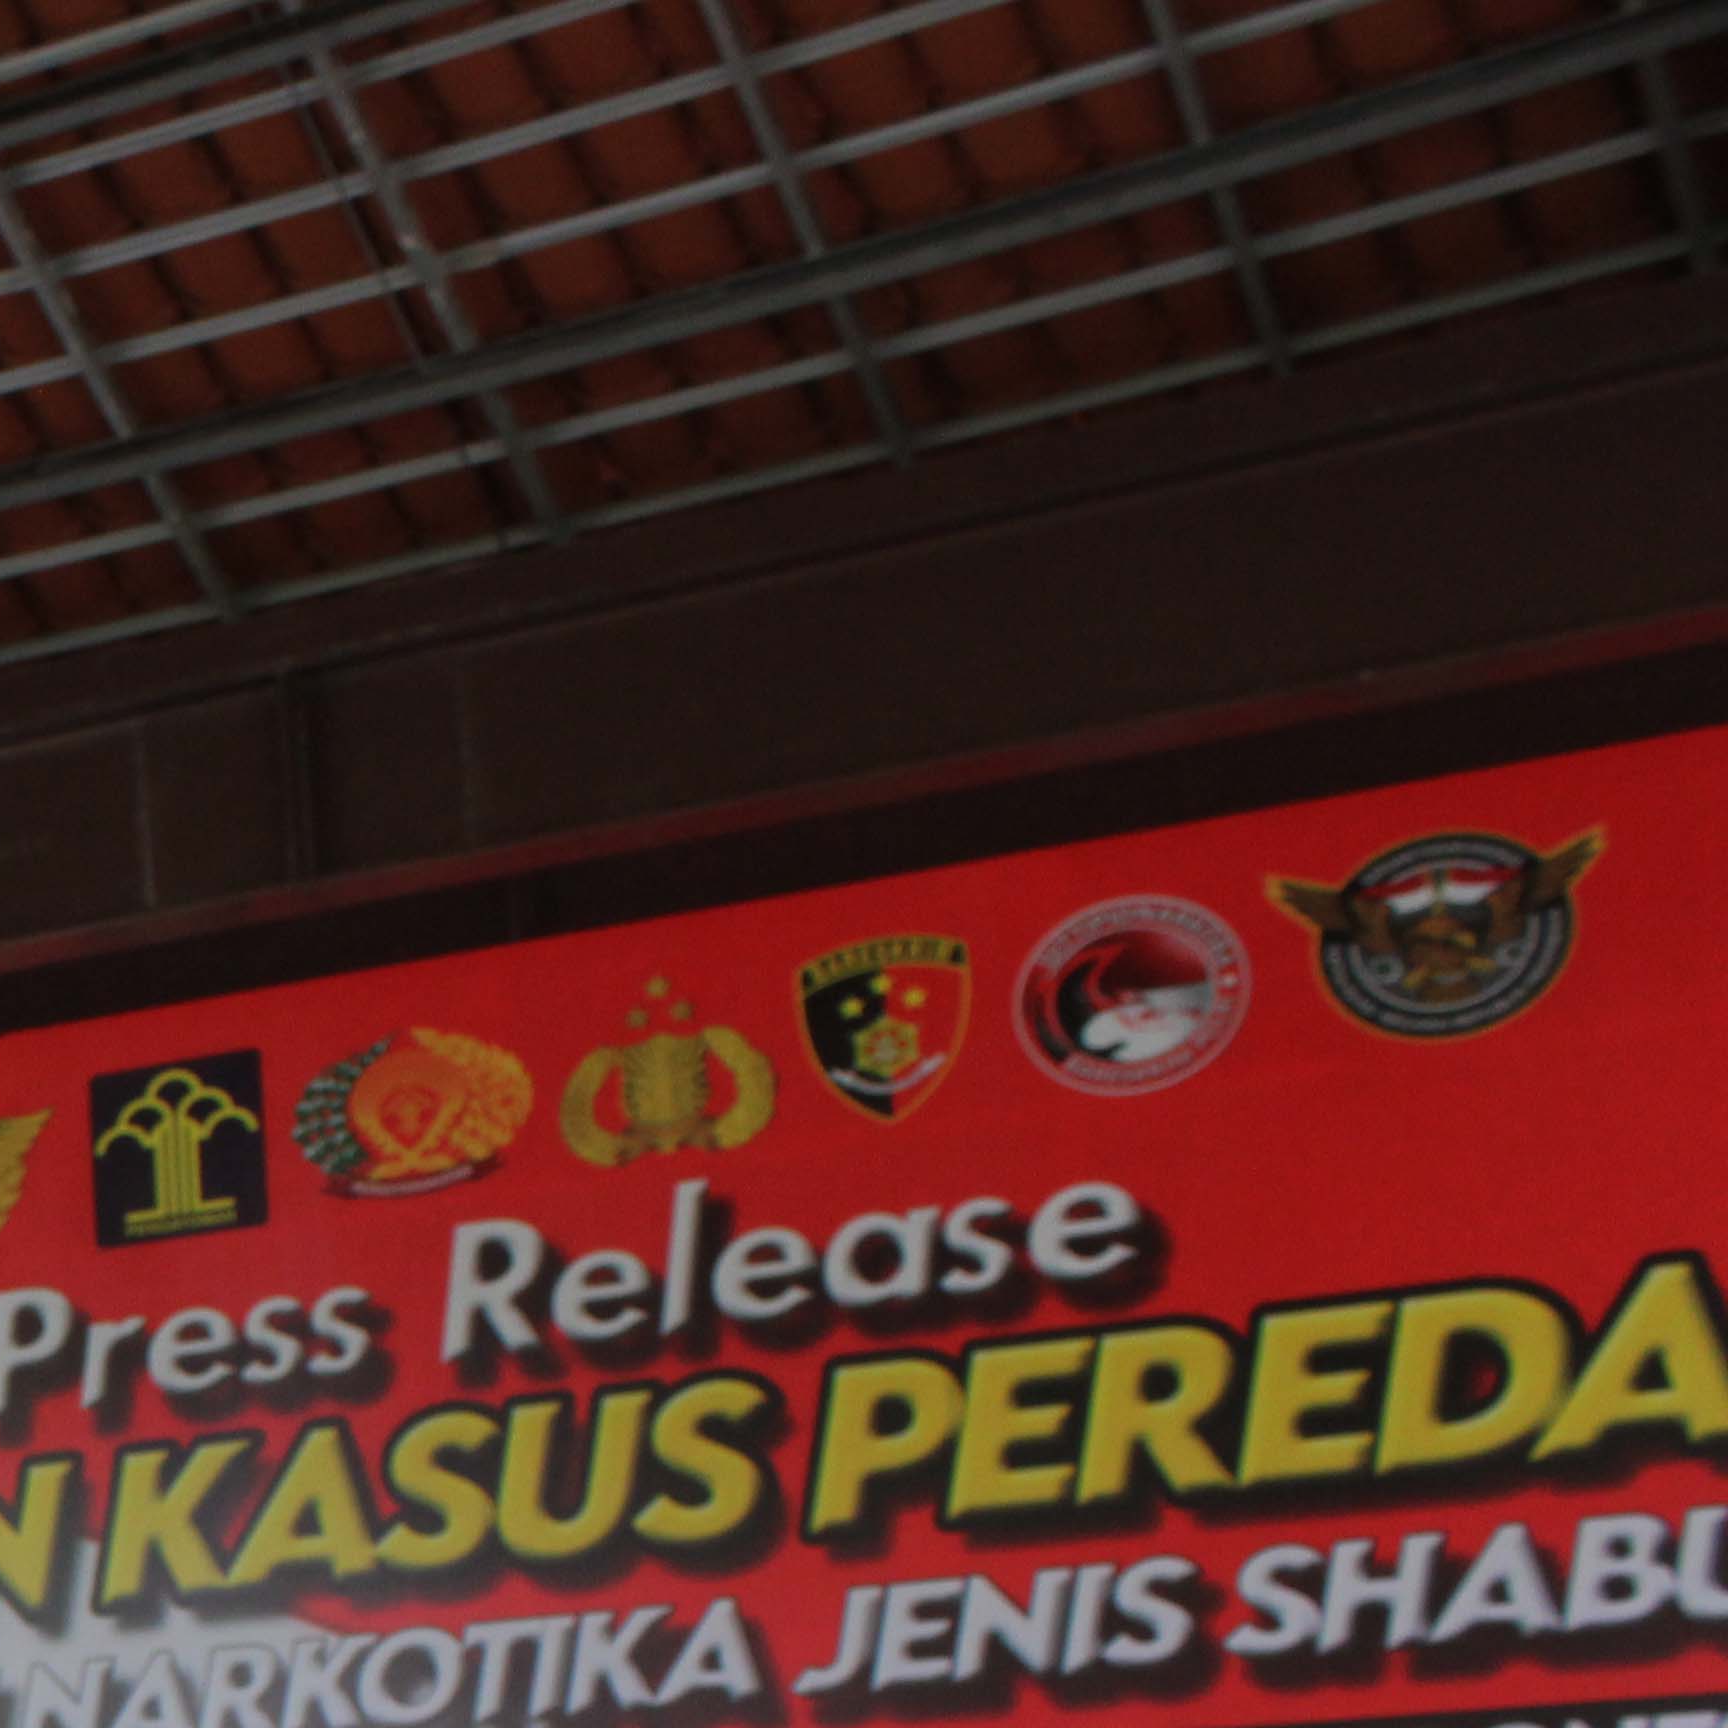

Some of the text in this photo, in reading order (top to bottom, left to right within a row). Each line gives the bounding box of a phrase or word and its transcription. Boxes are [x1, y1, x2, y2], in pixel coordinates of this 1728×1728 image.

[441, 1178, 1138, 1362] Release
[98, 1376, 769, 1604] KASUS
[794, 1556, 1197, 1694] JENIS
